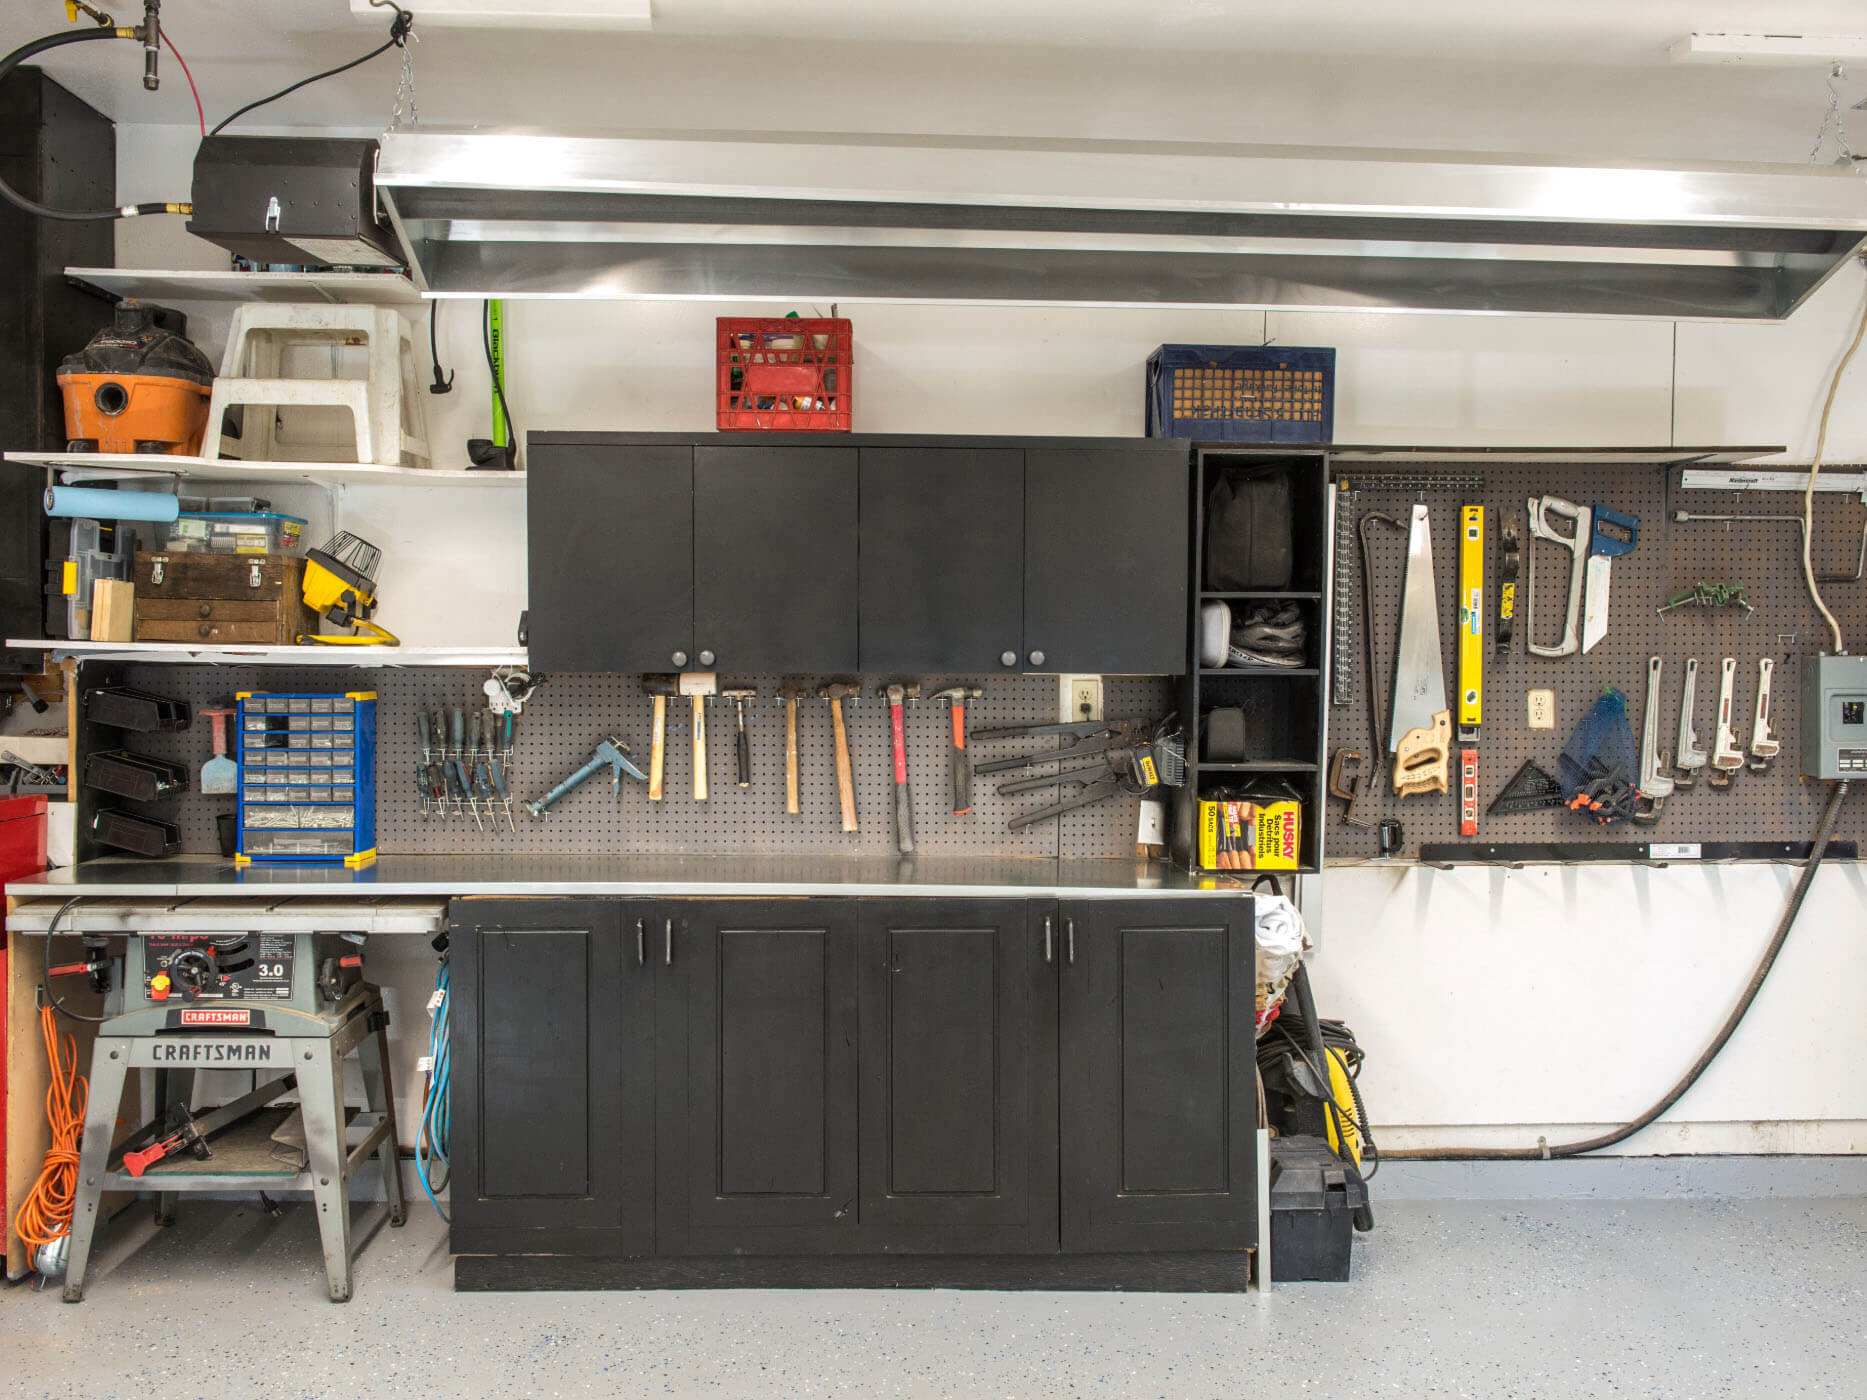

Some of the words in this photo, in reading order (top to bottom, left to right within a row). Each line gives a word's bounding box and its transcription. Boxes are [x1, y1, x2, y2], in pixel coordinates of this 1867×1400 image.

[1208, 806, 1216, 817] 50
[1258, 813, 1266, 859] Industriels
[1282, 811, 1296, 860] HUSKY
[1272, 837, 1280, 858] pour
[258, 964, 284, 977] 3.0
[185, 1013, 247, 1022] CRAFTSMAN
[153, 1044, 271, 1061] CRAFTSMAN
